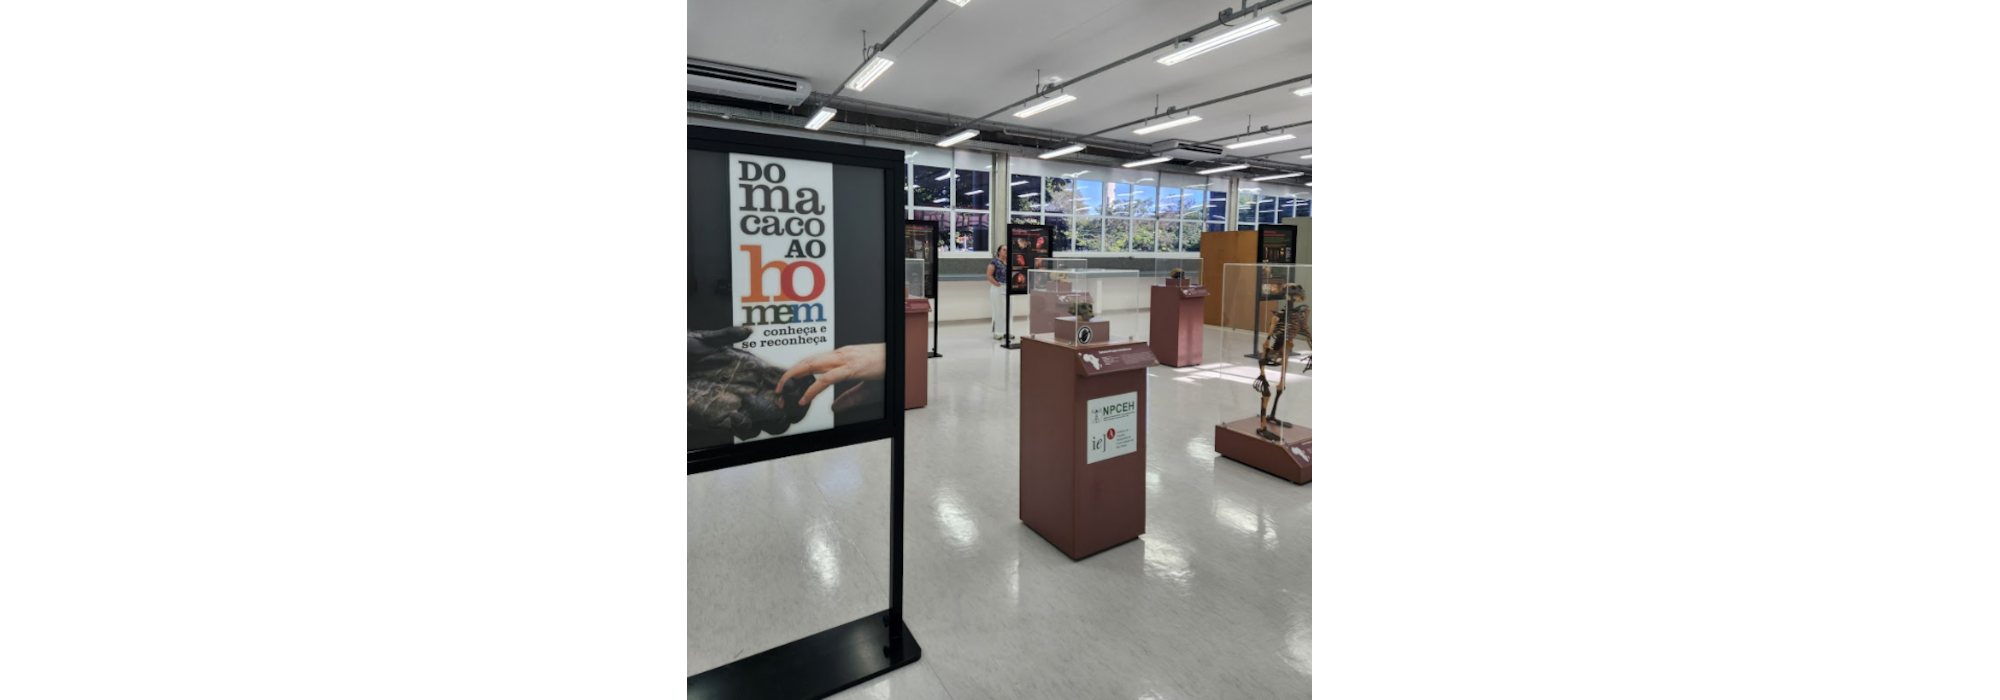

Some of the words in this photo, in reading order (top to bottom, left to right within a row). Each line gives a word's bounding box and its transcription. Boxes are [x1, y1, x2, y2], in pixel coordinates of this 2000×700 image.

[738, 161, 786, 184] DO
[738, 184, 826, 215] ma
[740, 214, 826, 238] caco
[784, 239, 827, 258] AO
[740, 244, 826, 303] ho
[741, 303, 828, 327] mem
[741, 341, 757, 349] se
[759, 335, 827, 348] reconheça
[763, 326, 817, 337] conheça
[820, 325, 827, 333] e
[1103, 401, 1135, 416] NPCEH
